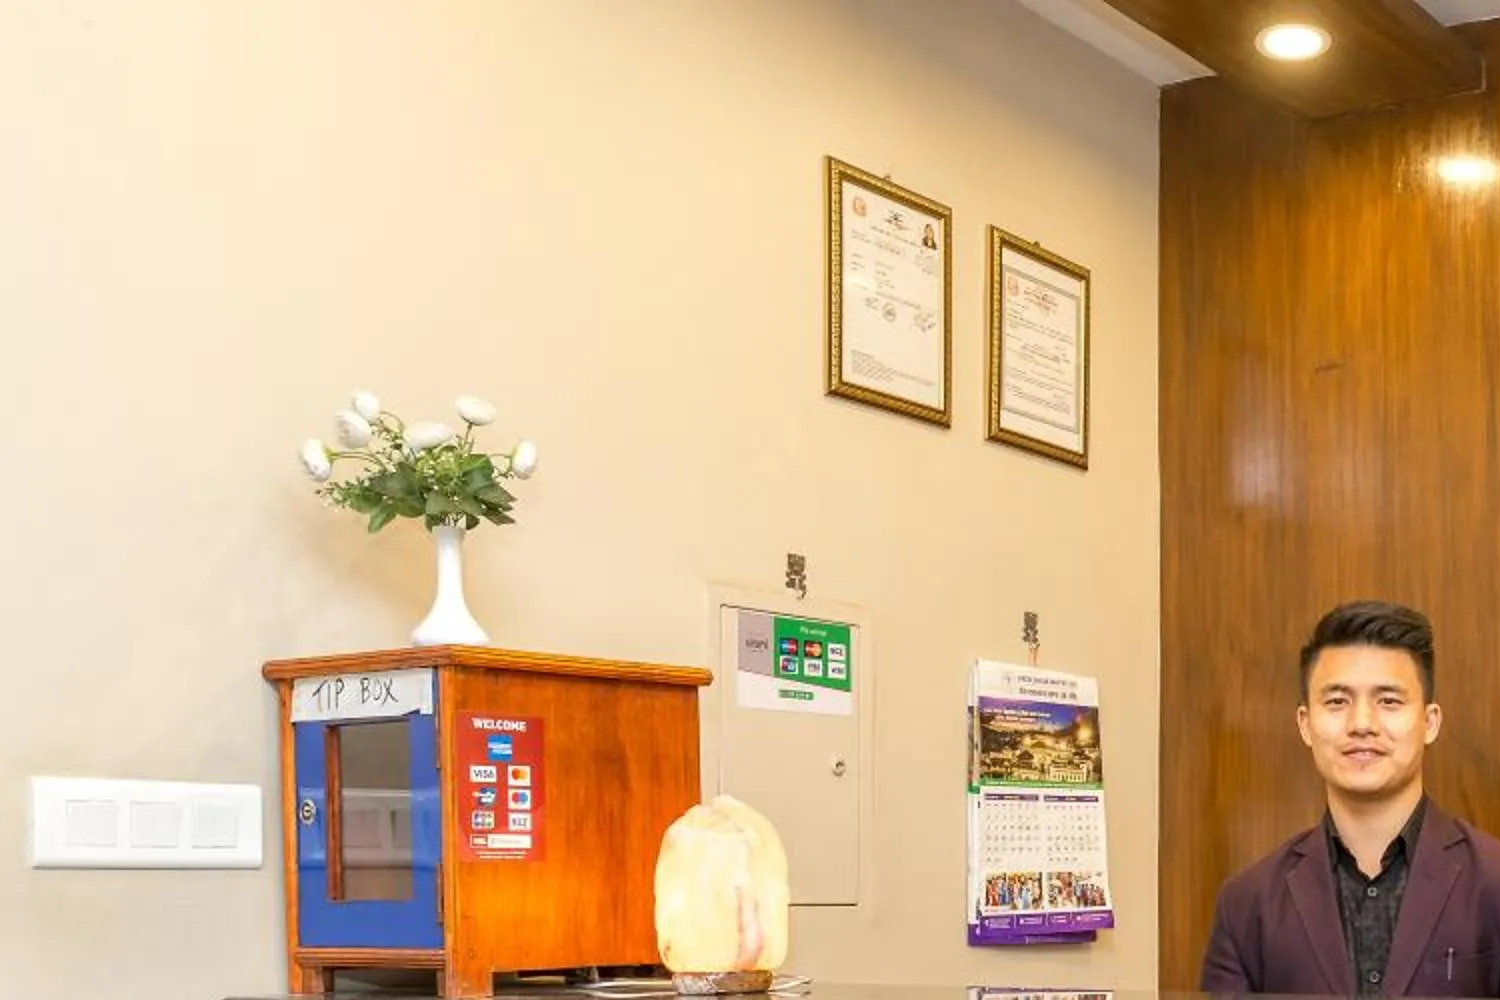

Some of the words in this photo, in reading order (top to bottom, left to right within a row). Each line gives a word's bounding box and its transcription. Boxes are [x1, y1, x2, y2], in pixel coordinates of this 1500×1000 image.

[311, 677, 345, 713] TIP
[360, 676, 399, 706] BOX
[472, 718, 527, 732] WELCOME
[473, 769, 495, 779] VISA
